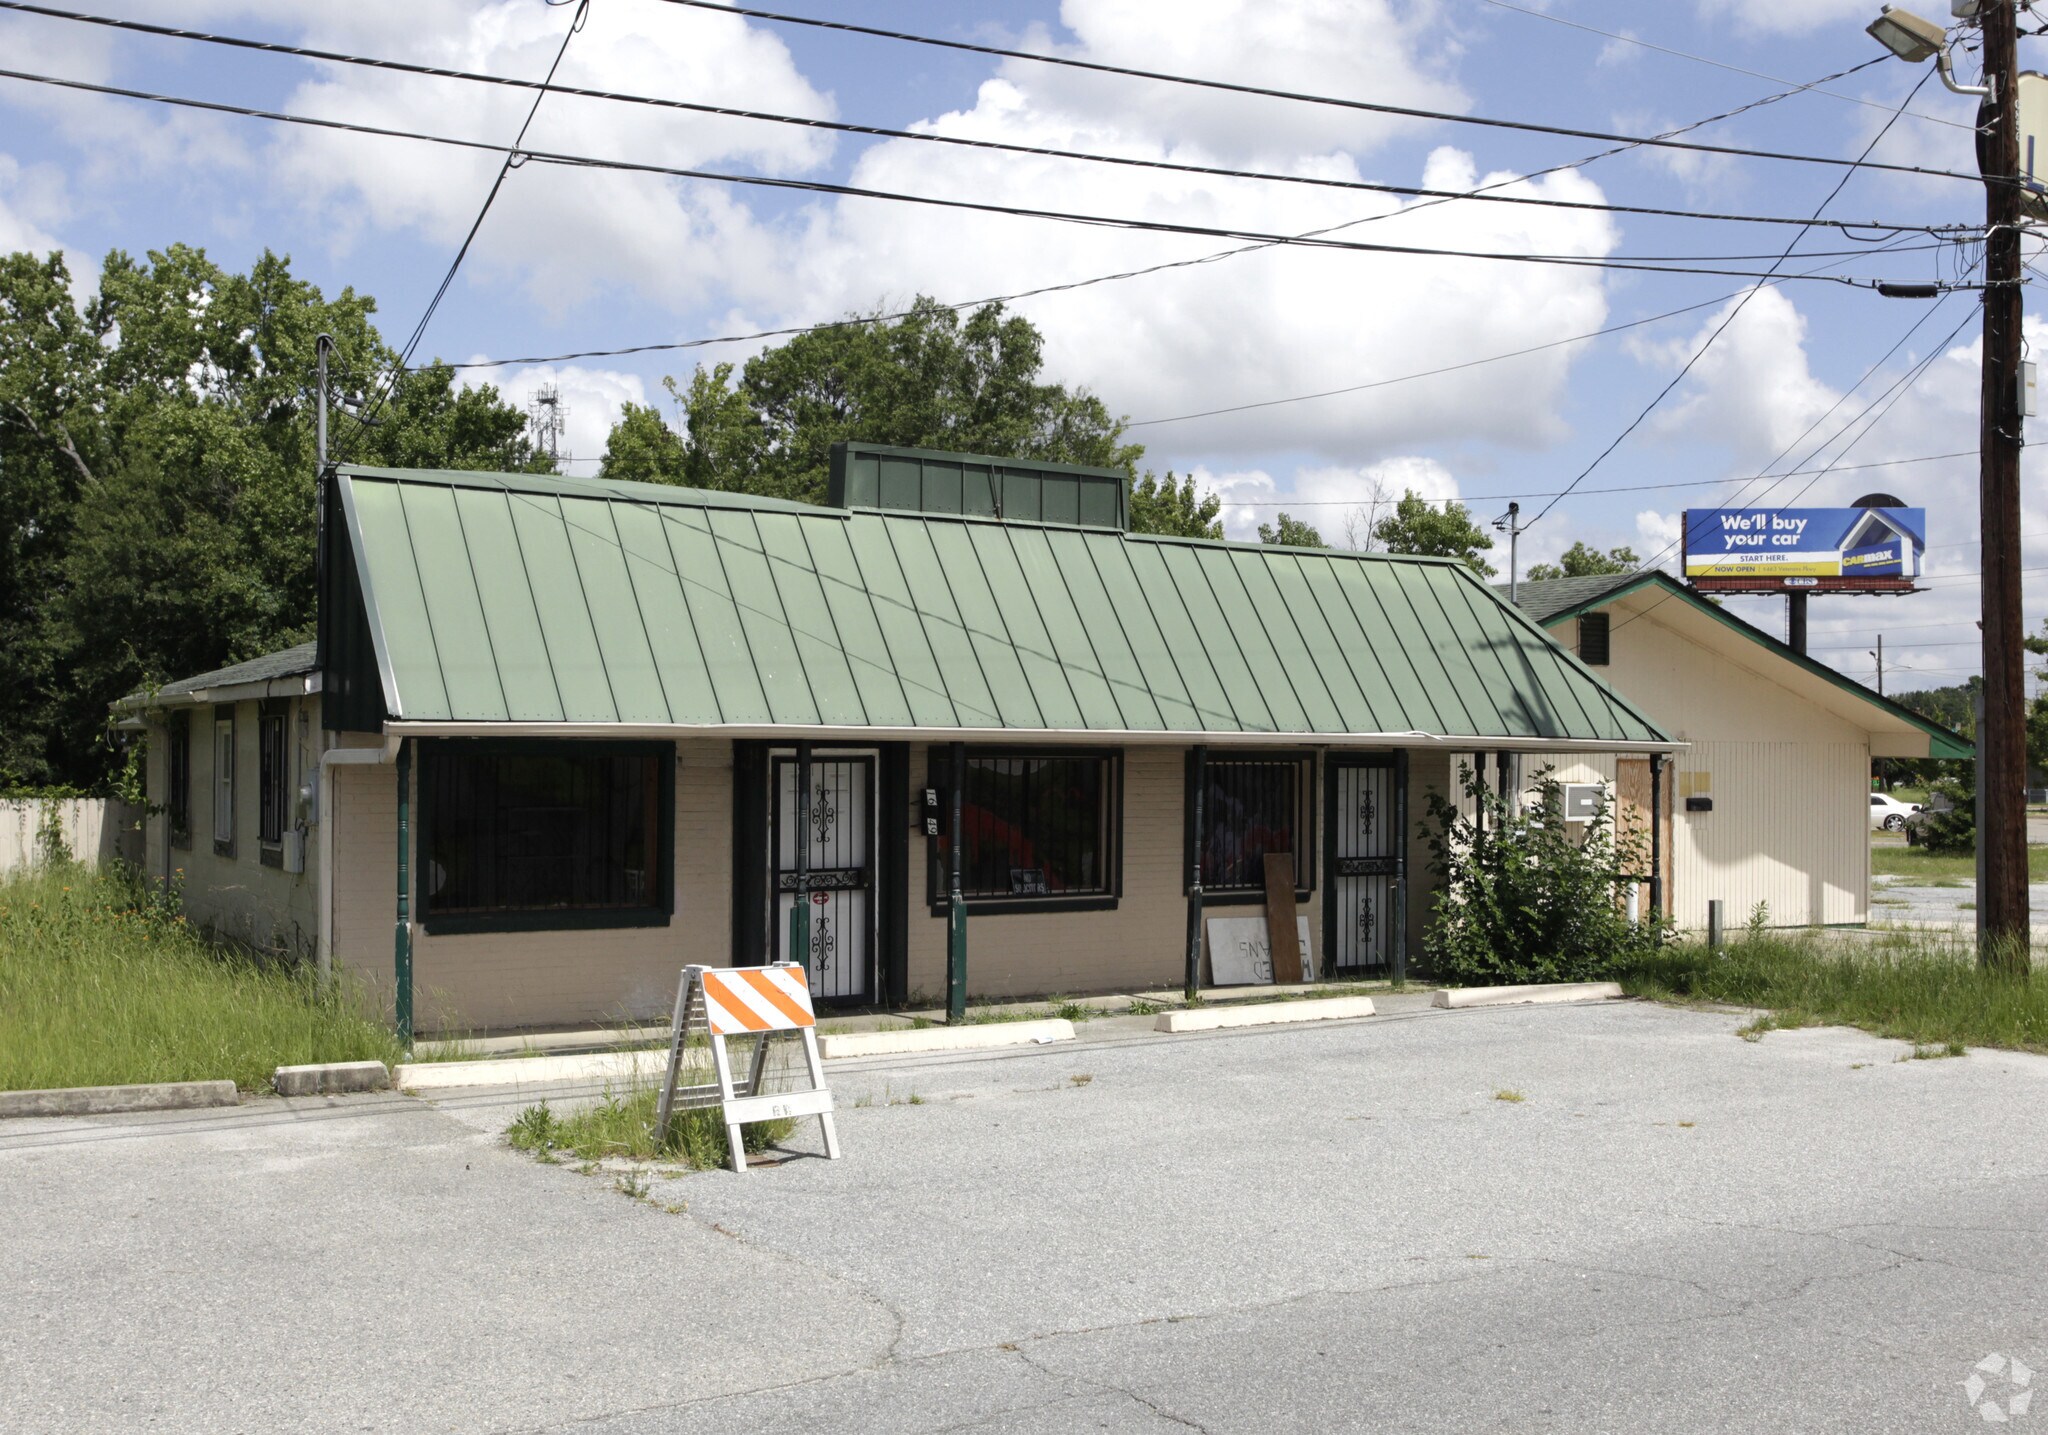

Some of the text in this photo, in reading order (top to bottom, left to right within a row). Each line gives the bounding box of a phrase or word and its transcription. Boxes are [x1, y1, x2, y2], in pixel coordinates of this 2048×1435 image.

[1721, 514, 1808, 534] We'll buy
[1724, 534, 1801, 550] your car
